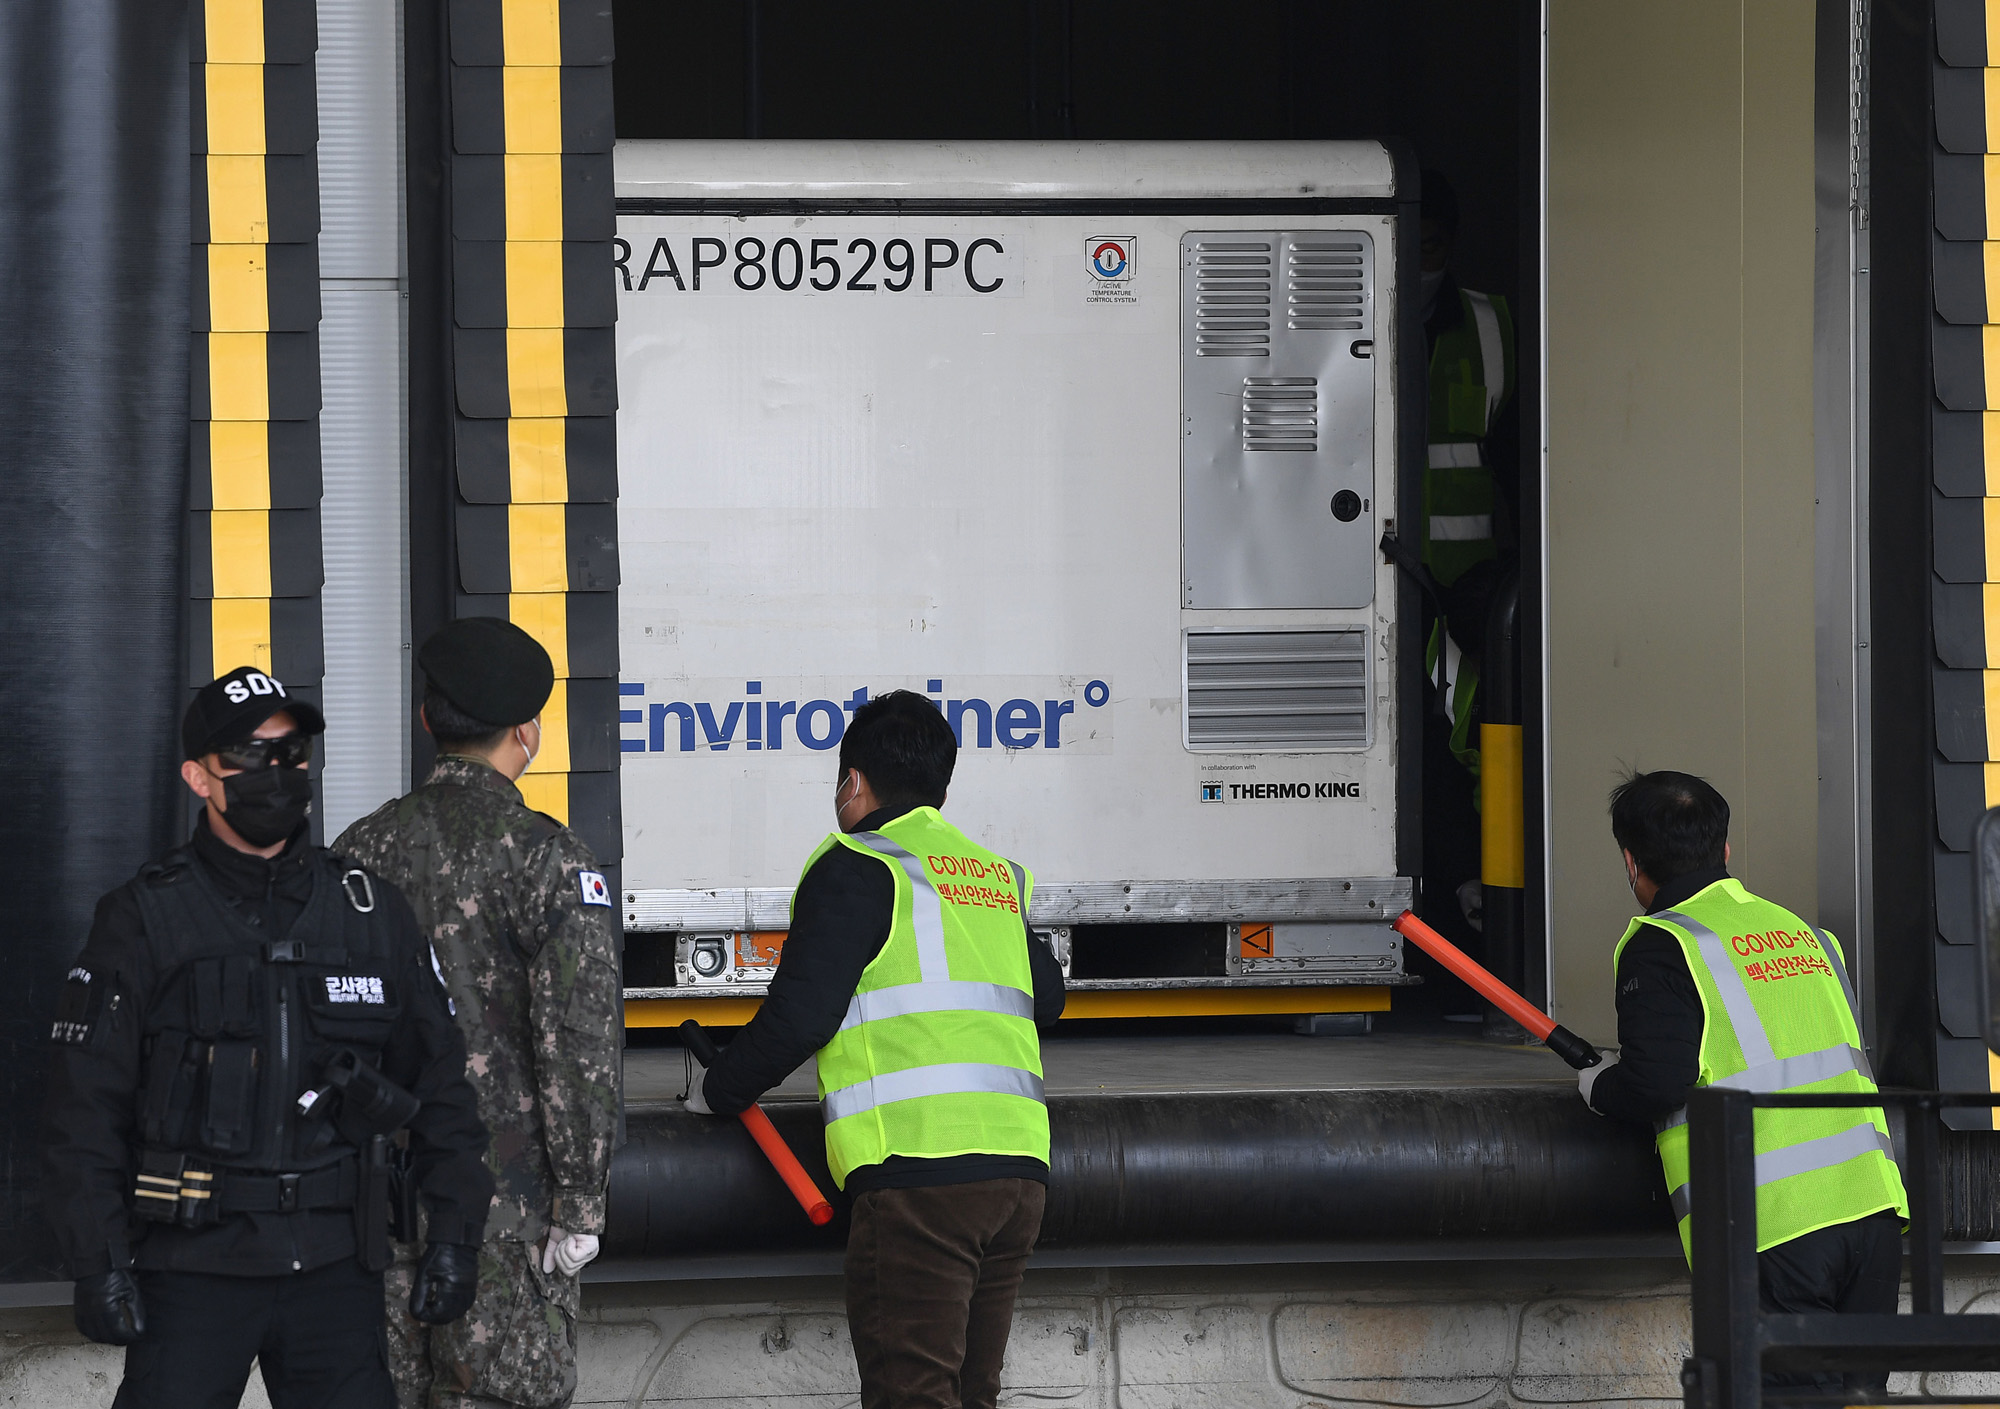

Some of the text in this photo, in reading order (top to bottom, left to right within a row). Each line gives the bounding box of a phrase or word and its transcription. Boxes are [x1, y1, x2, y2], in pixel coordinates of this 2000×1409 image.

[613, 237, 1004, 293] RAP80529PC
[619, 679, 1073, 752] Environer
[1229, 783, 1311, 799] THERMO
[1315, 782, 1360, 798] KING
[927, 855, 1011, 885] COVID-19
[936, 883, 1019, 914] 백신안전수송
[1731, 929, 1819, 957] COVID-19
[1744, 954, 1833, 983] 백신안전수송
[325, 976, 384, 995] 군사경찰
